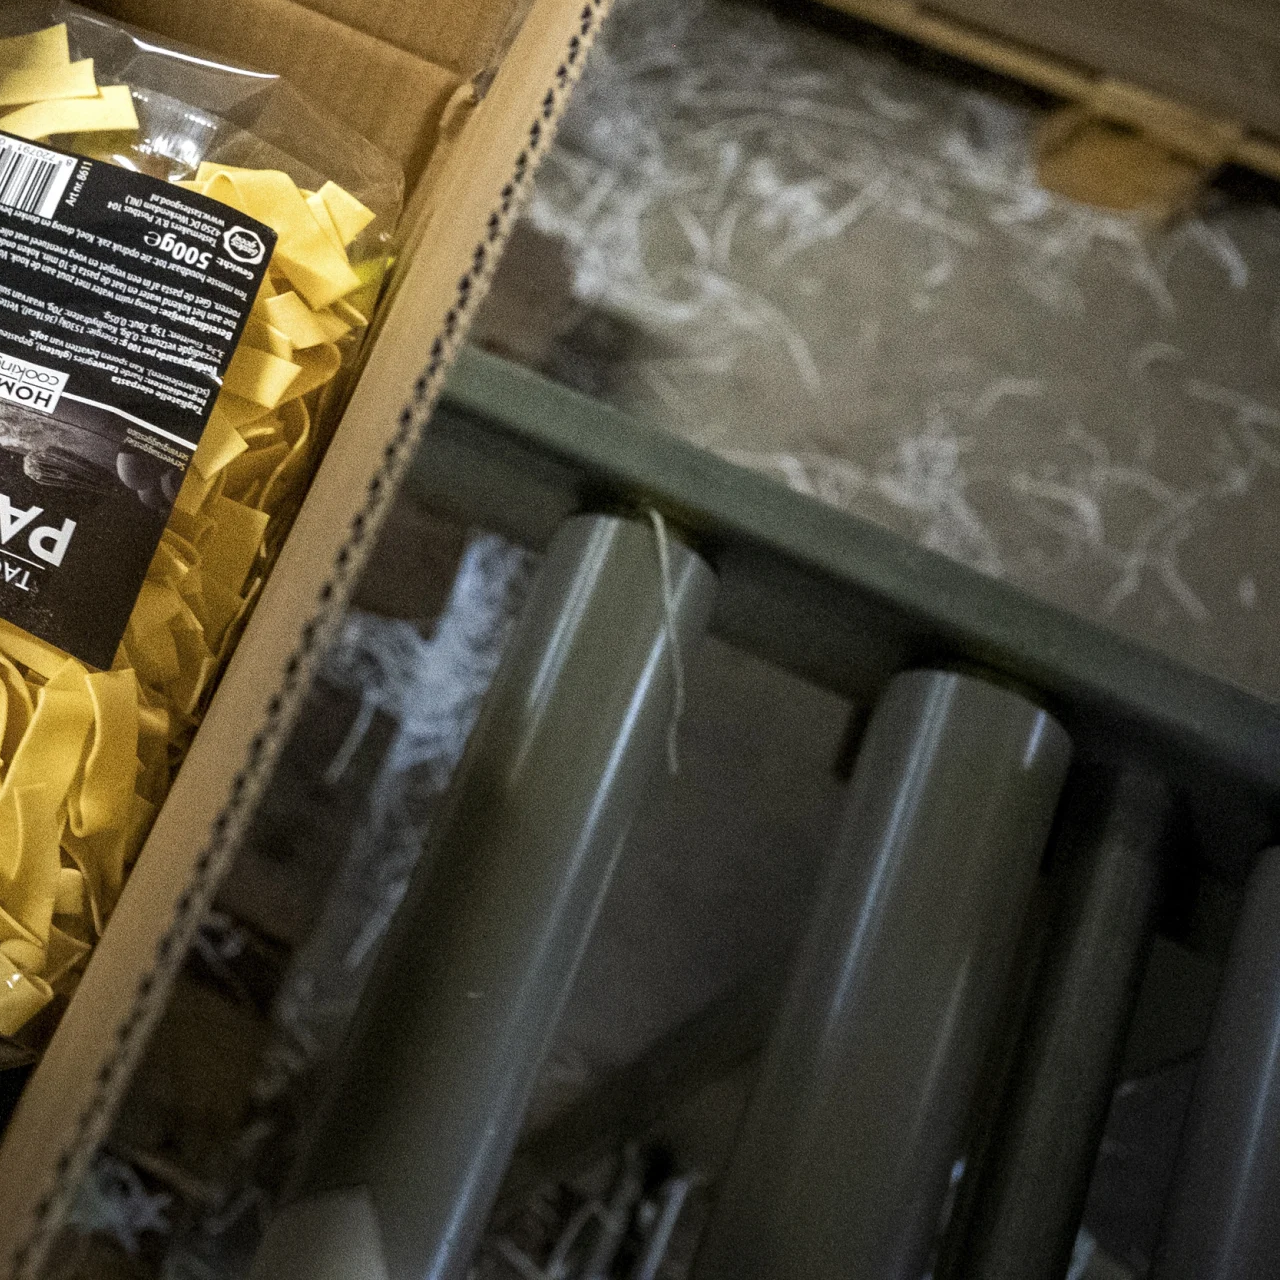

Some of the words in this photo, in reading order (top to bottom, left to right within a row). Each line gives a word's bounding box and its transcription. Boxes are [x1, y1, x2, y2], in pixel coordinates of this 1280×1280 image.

[17, 144, 55, 162] 720791
[66, 159, 73, 167] 8
[76, 161, 92, 181] 8611
[73, 182, 84, 192] nr.
[65, 192, 79, 207] Art
[125, 195, 143, 207] (NL)
[107, 201, 122, 212] 104
[150, 194, 224, 226] www.tastesgood.nl
[13, 210, 40, 224] donker
[124, 206, 154, 222] Postbus
[143, 202, 189, 225] Werkendam
[41, 219, 51, 227] en
[51, 221, 75, 235] droog
[155, 216, 170, 228] B.V.
[189, 218, 201, 229] DC
[0, 227, 14, 237] olie
[76, 229, 95, 243] Koel,
[171, 222, 217, 247] Tastemakers
[201, 223, 221, 236] 4250
[14, 232, 29, 241] wat
[96, 236, 112, 247] zak.
[17, 244, 40, 259] koken
[29, 237, 68, 255] eventueel
[112, 243, 140, 258] opdruk
[10, 253, 30, 267] kook.
[42, 252, 59, 264] min.
[68, 249, 87, 263] voeg
[88, 258, 99, 267] en
[140, 253, 153, 263] zie
[152, 257, 167, 268] tot:
[30, 261, 41, 271] de
[41, 265, 57, 275] aan
[58, 259, 78, 273] 8-10
[99, 262, 126, 278] vergiet
[216, 257, 254, 280] Gewicht:
[56, 271, 75, 283] zout
[78, 267, 101, 280] pasta
[127, 273, 142, 283] een
[167, 263, 206, 283] houdbaar
[74, 278, 91, 289] met
[100, 275, 111, 286] de
[111, 280, 127, 293] laat
[142, 279, 151, 289] in
[150, 282, 161, 290] af
[206, 276, 234, 292] minste
[91, 285, 114, 298] water
[127, 286, 138, 294] en
[138, 290, 161, 302] water
[161, 285, 184, 297] pasta
[234, 288, 247, 301] Ten
[12, 291, 45, 308] waarvan
[115, 293, 134, 304] ruim
[183, 292, 195, 303] de
[195, 296, 212, 308] Giet
[134, 298, 158, 314] Breng
[161, 298, 192, 314] kokend
[191, 307, 206, 319] het
[207, 313, 223, 323] aan
[64, 309, 118, 334] Koolhydraten:
[128, 320, 149, 333] Zout:
[159, 309, 233, 340] Bereidingswijze:
[223, 318, 237, 329] toe
[29, 329, 49, 341] soja.
[49, 337, 64, 346] van
[86, 328, 118, 345] Energie:
[127, 343, 141, 353] 100
[140, 335, 176, 350] vetzuren:
[65, 342, 100, 358] bevatten
[142, 347, 157, 356] per
[177, 345, 221, 364] verzadigde
[74, 355, 119, 373] tarwegries
[101, 352, 128, 365] sporen
[129, 363, 144, 373] Kan
[120, 368, 143, 382] harde
[111, 376, 154, 394] eierpasta
[144, 377, 206, 406] Ingrediënten:
[155, 391, 202, 415] Tagliatelle
